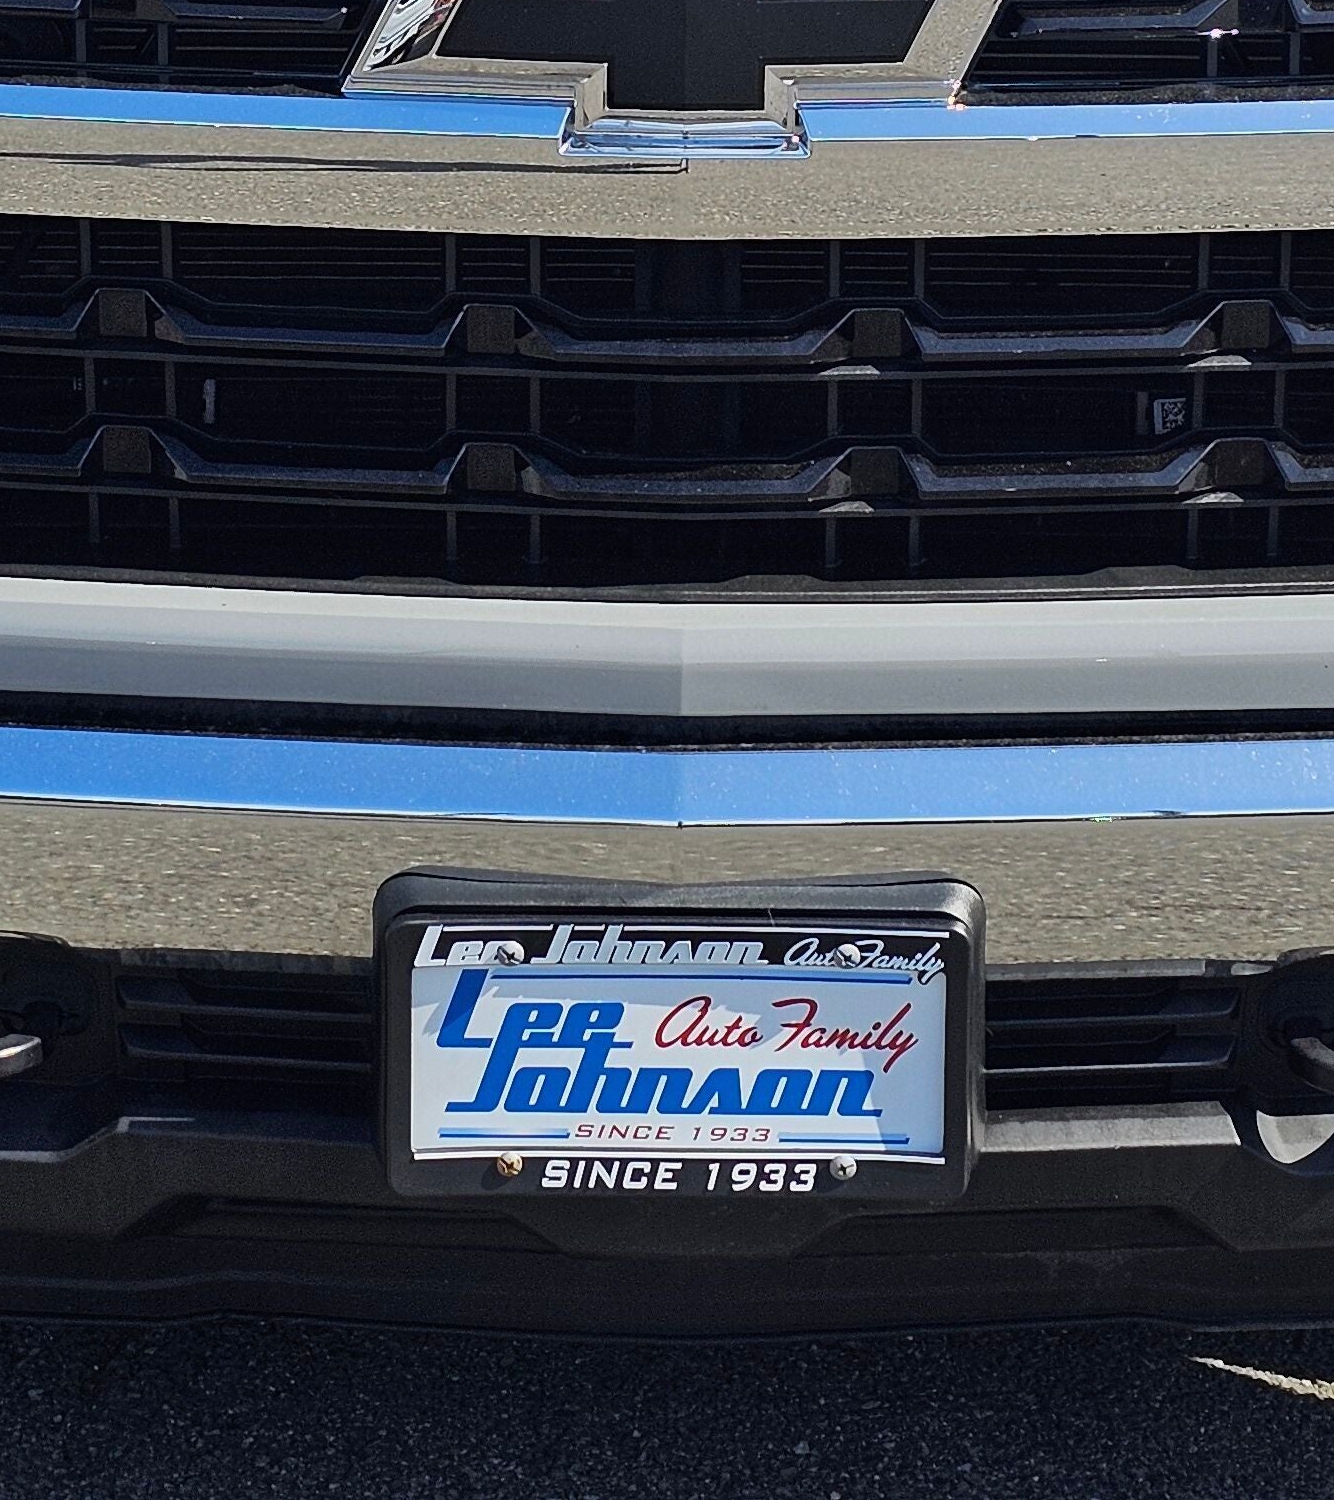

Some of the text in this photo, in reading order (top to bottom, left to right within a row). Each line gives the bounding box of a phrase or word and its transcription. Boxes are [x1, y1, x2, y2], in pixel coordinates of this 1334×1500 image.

[531, 925, 769, 966] Johnson
[784, 938, 855, 966] Aut
[855, 939, 945, 984] Family
[436, 969, 918, 1074] Lee Auto Family
[445, 1040, 882, 1117] Johnson
[575, 1124, 771, 1143] SINCE 1933
[541, 1160, 817, 1193] SINCE 1933
